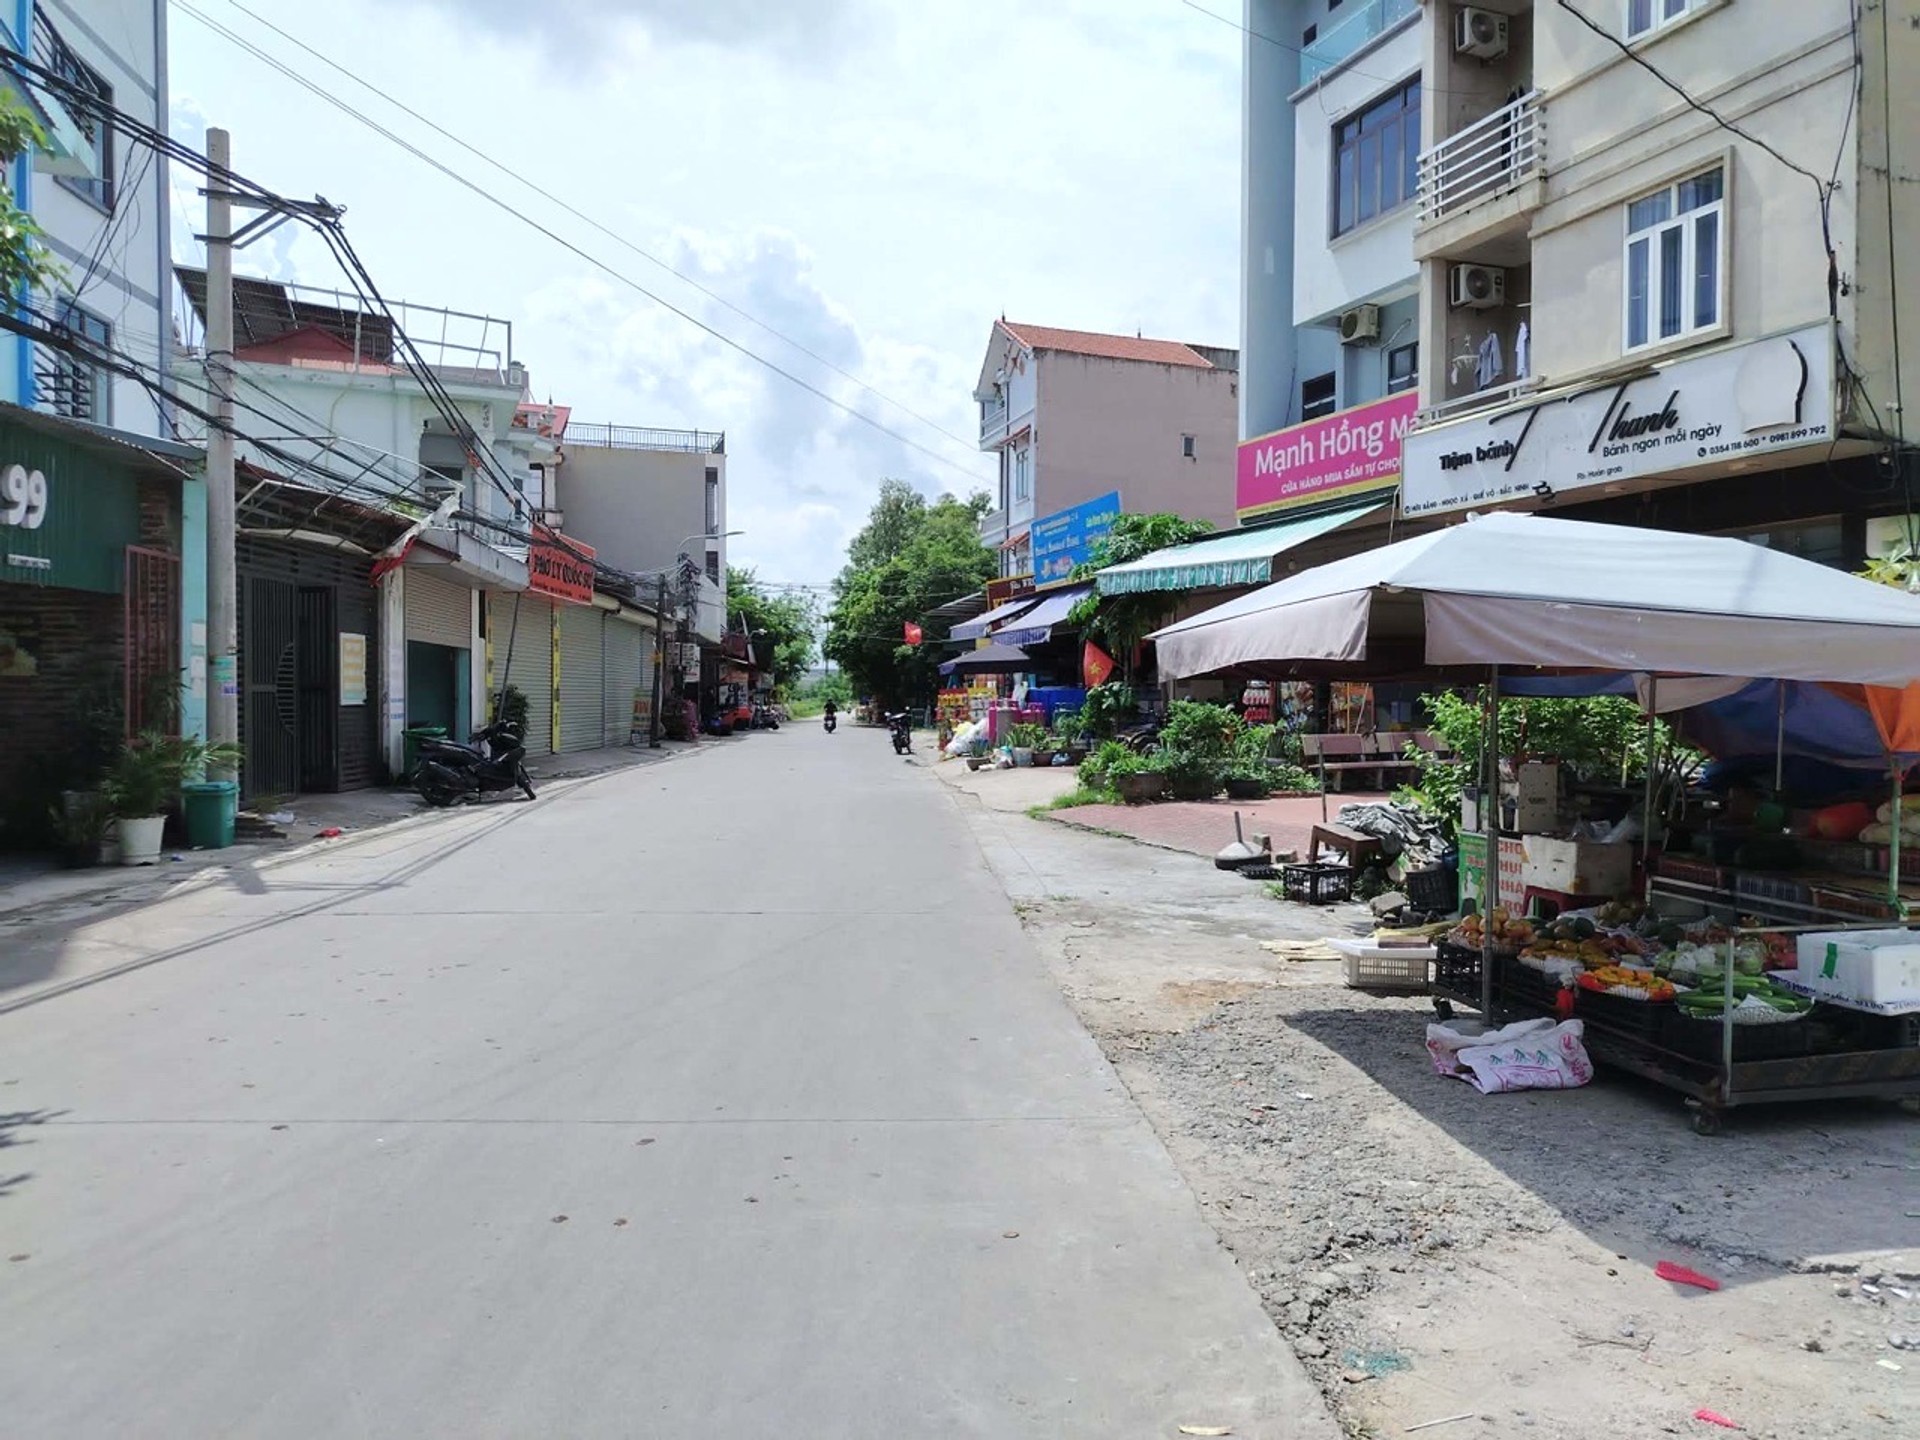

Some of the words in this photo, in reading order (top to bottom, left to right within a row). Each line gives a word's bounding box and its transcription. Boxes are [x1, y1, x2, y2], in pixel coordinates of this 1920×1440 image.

[1568, 371, 1679, 453] Thanh
[1255, 434, 1314, 478] Mạnh
[1320, 418, 1385, 458] Hồng
[1439, 451, 1473, 471] Tiệm
[1476, 440, 1515, 462] bánh
[1603, 441, 1630, 457] Bánh
[1632, 437, 1661, 454] ngon
[1664, 427, 1687, 446] mỗi
[1690, 422, 1722, 441] ngày
[1709, 445, 1730, 455] 0354
[1743, 437, 1760, 448] 600
[1769, 433, 1790, 444] 0981
[1790, 429, 1808, 439] 899
[1809, 425, 1827, 436] 792
[1281, 480, 1298, 494] CỦA
[1299, 477, 1323, 490] HÀNG
[1324, 473, 1343, 485] MUA
[1344, 463, 1364, 480] SẮM
[1365, 459, 1376, 476] TỰ
